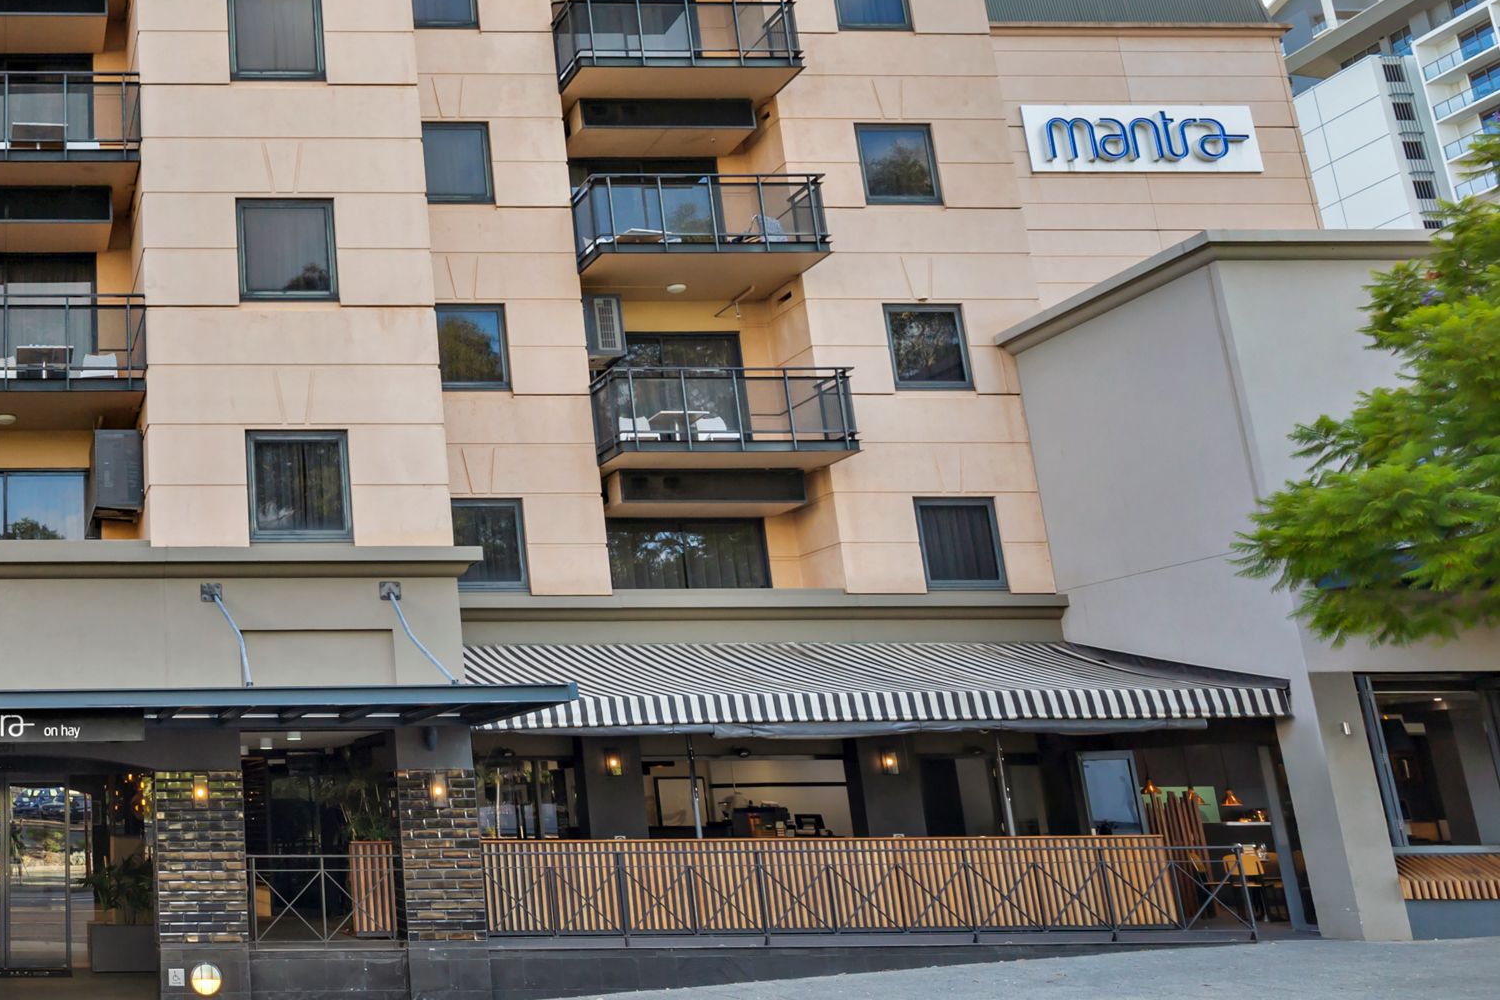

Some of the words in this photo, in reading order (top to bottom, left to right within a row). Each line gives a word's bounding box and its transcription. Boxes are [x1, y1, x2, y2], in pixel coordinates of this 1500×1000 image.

[1044, 110, 1250, 160] mantra
[43, 726, 58, 737] on
[60, 725, 80, 738] hay
